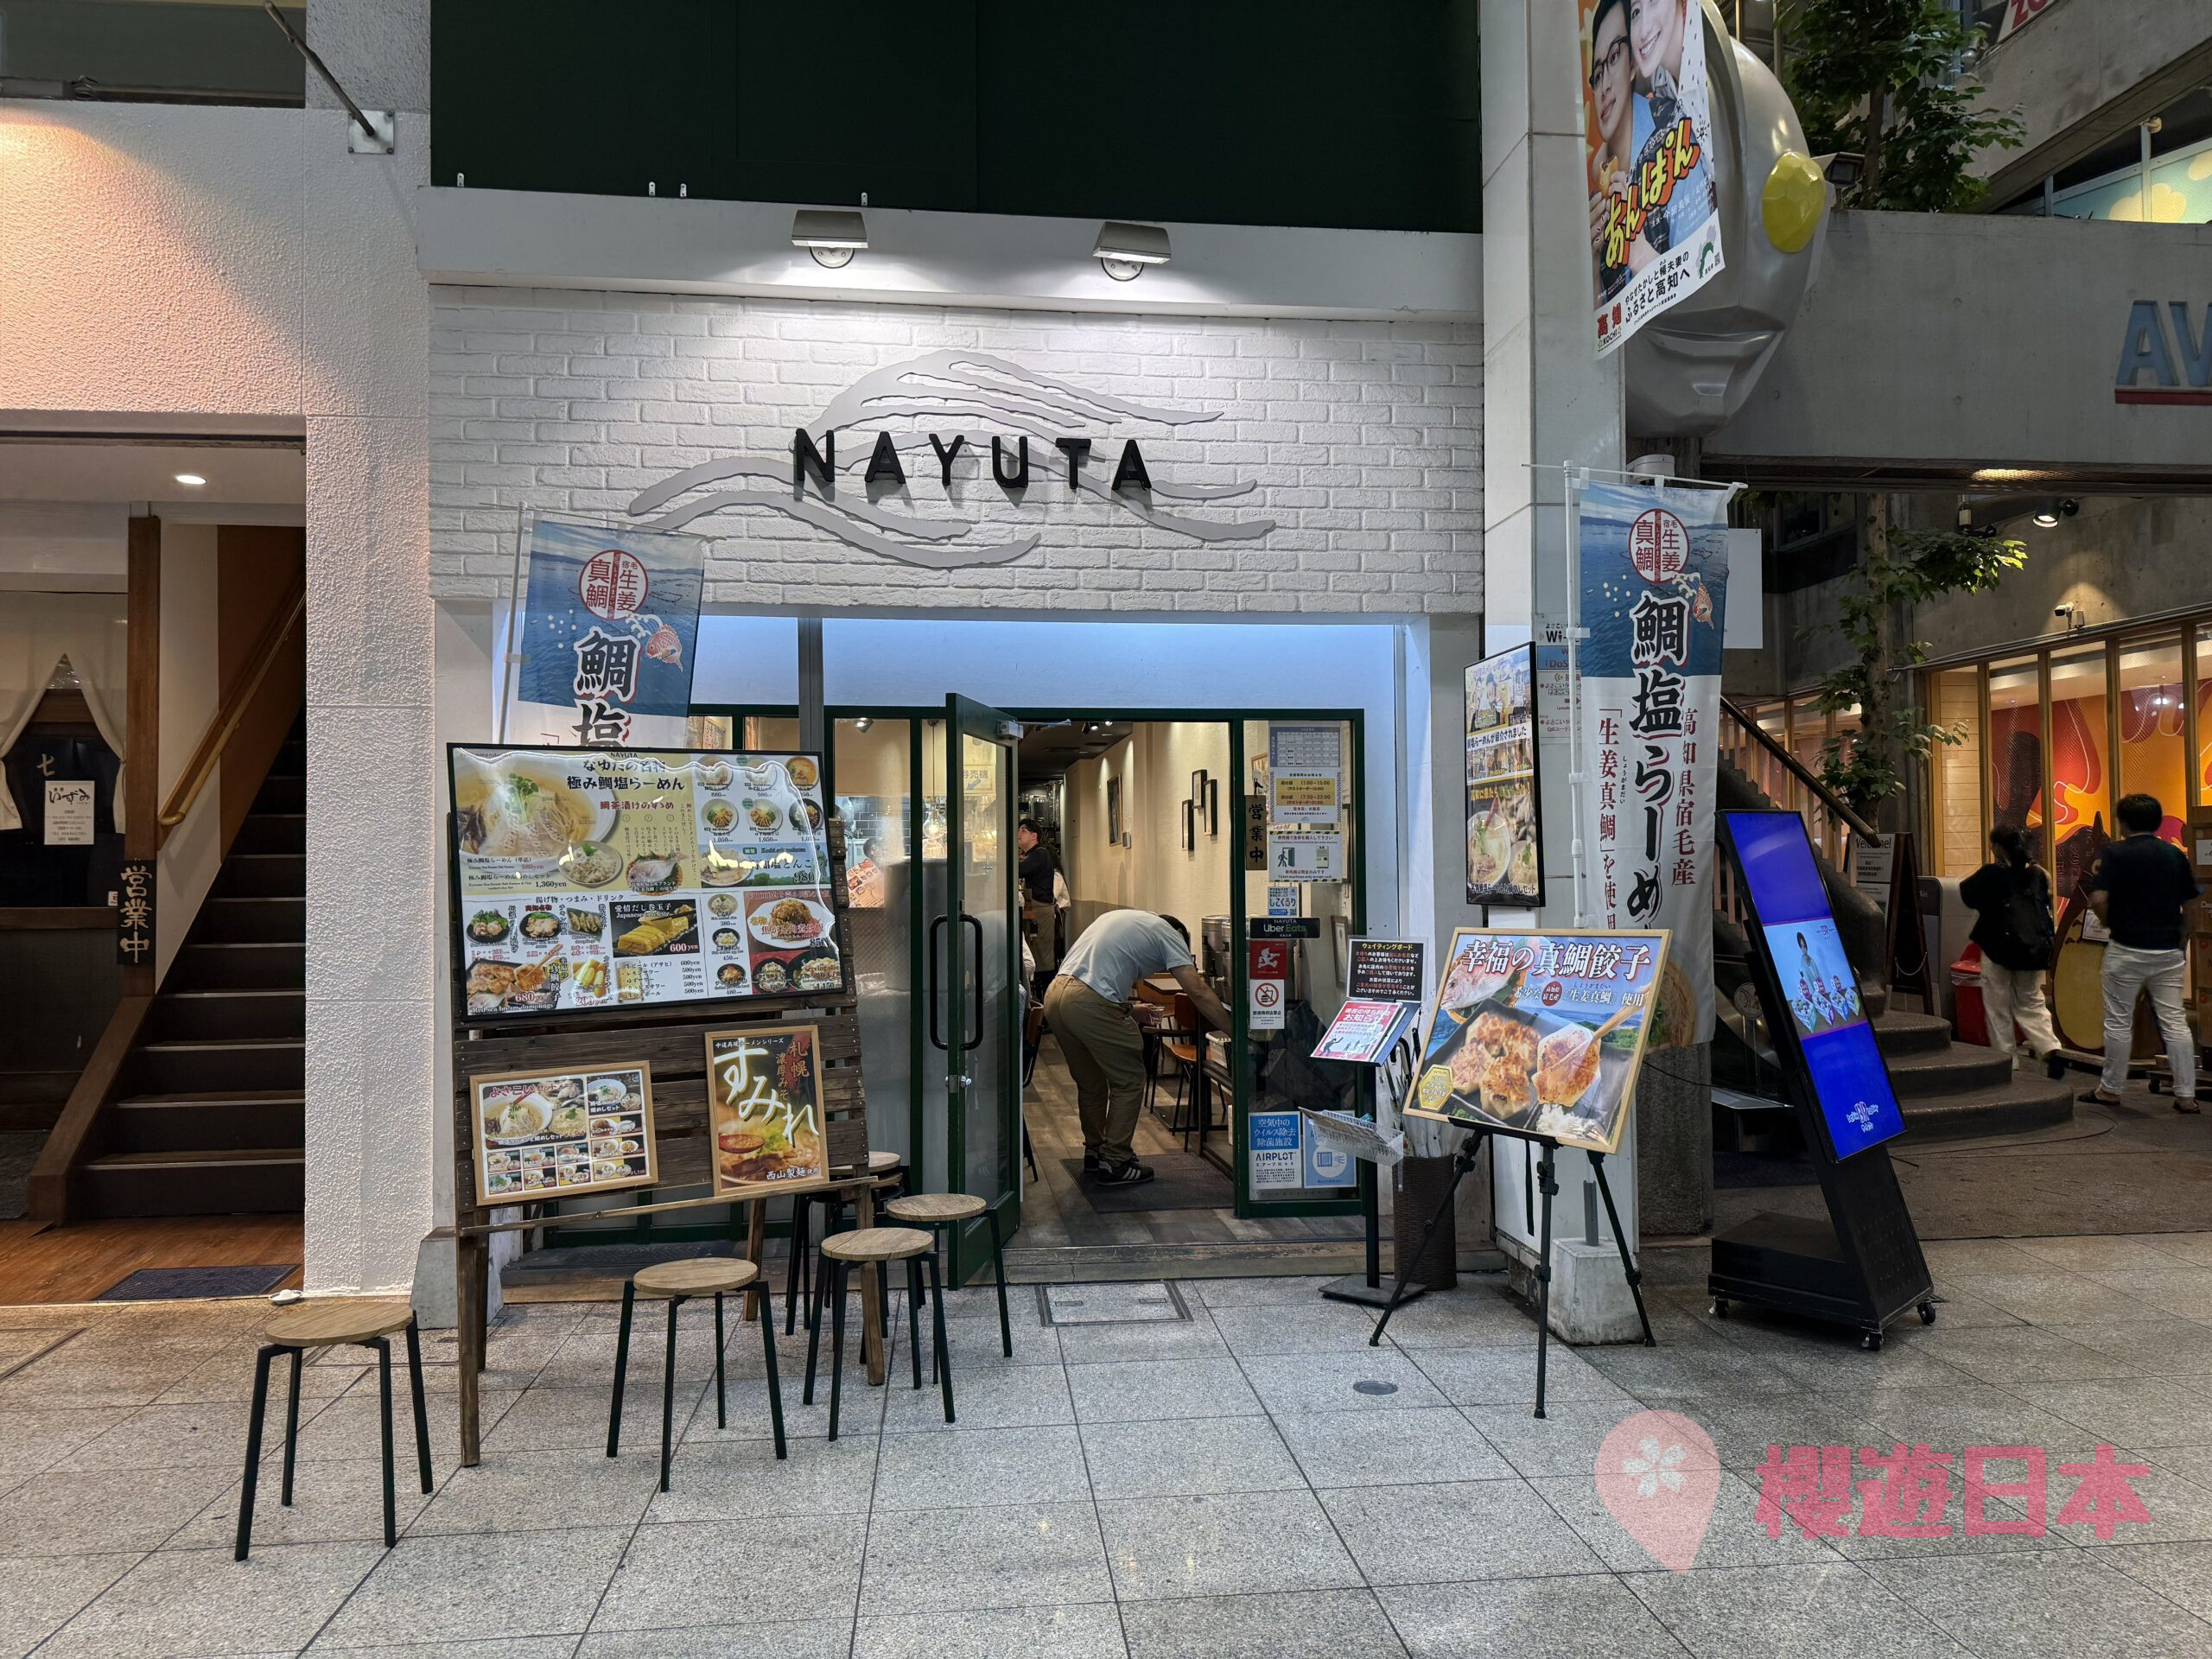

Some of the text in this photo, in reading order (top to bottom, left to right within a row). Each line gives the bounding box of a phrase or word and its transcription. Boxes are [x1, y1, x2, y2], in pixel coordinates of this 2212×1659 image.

[1605, 116, 1700, 270] あんぱん
[1626, 269, 1690, 323] ふるさと高知へ
[1597, 302, 1622, 339] 高知
[795, 427, 1154, 492] NAYUTA
[1636, 520, 1654, 572] 真鯛
[1662, 529, 1681, 572] 生姜
[586, 560, 612, 609] 真鯛
[617, 569, 639, 612] 生姜
[48, 788, 91, 805] いずみ
[567, 776, 685, 791] 極み鯛塩らーめん
[1671, 709, 1699, 886] 高知県宿毛産
[1249, 804, 1265, 863] 営業中
[119, 866, 152, 963] 営業中
[536, 893, 624, 904] 揚げ物・つまみ・ドリンク
[615, 903, 672, 912] 愛情だし巻玉子
[670, 944, 687, 952] 600
[1462, 939, 1650, 981] 幸福の真鯛餃子
[515, 991, 534, 1002] 680
[1515, 986, 1541, 1000] 希少な
[1621, 992, 1644, 1007] 使用
[776, 1053, 788, 1101] 濃厚みそ
[789, 1042, 810, 1077] 札幌
[490, 1084, 536, 1098] よさこい
[714, 1037, 819, 1148] すみれ
[1254, 1128, 1296, 1137] ウイルス除去
[1258, 1118, 1290, 1127] 空気中の
[1255, 1152, 1294, 1161] AIRPLOT
[1256, 1137, 1293, 1147] 除菌施設
